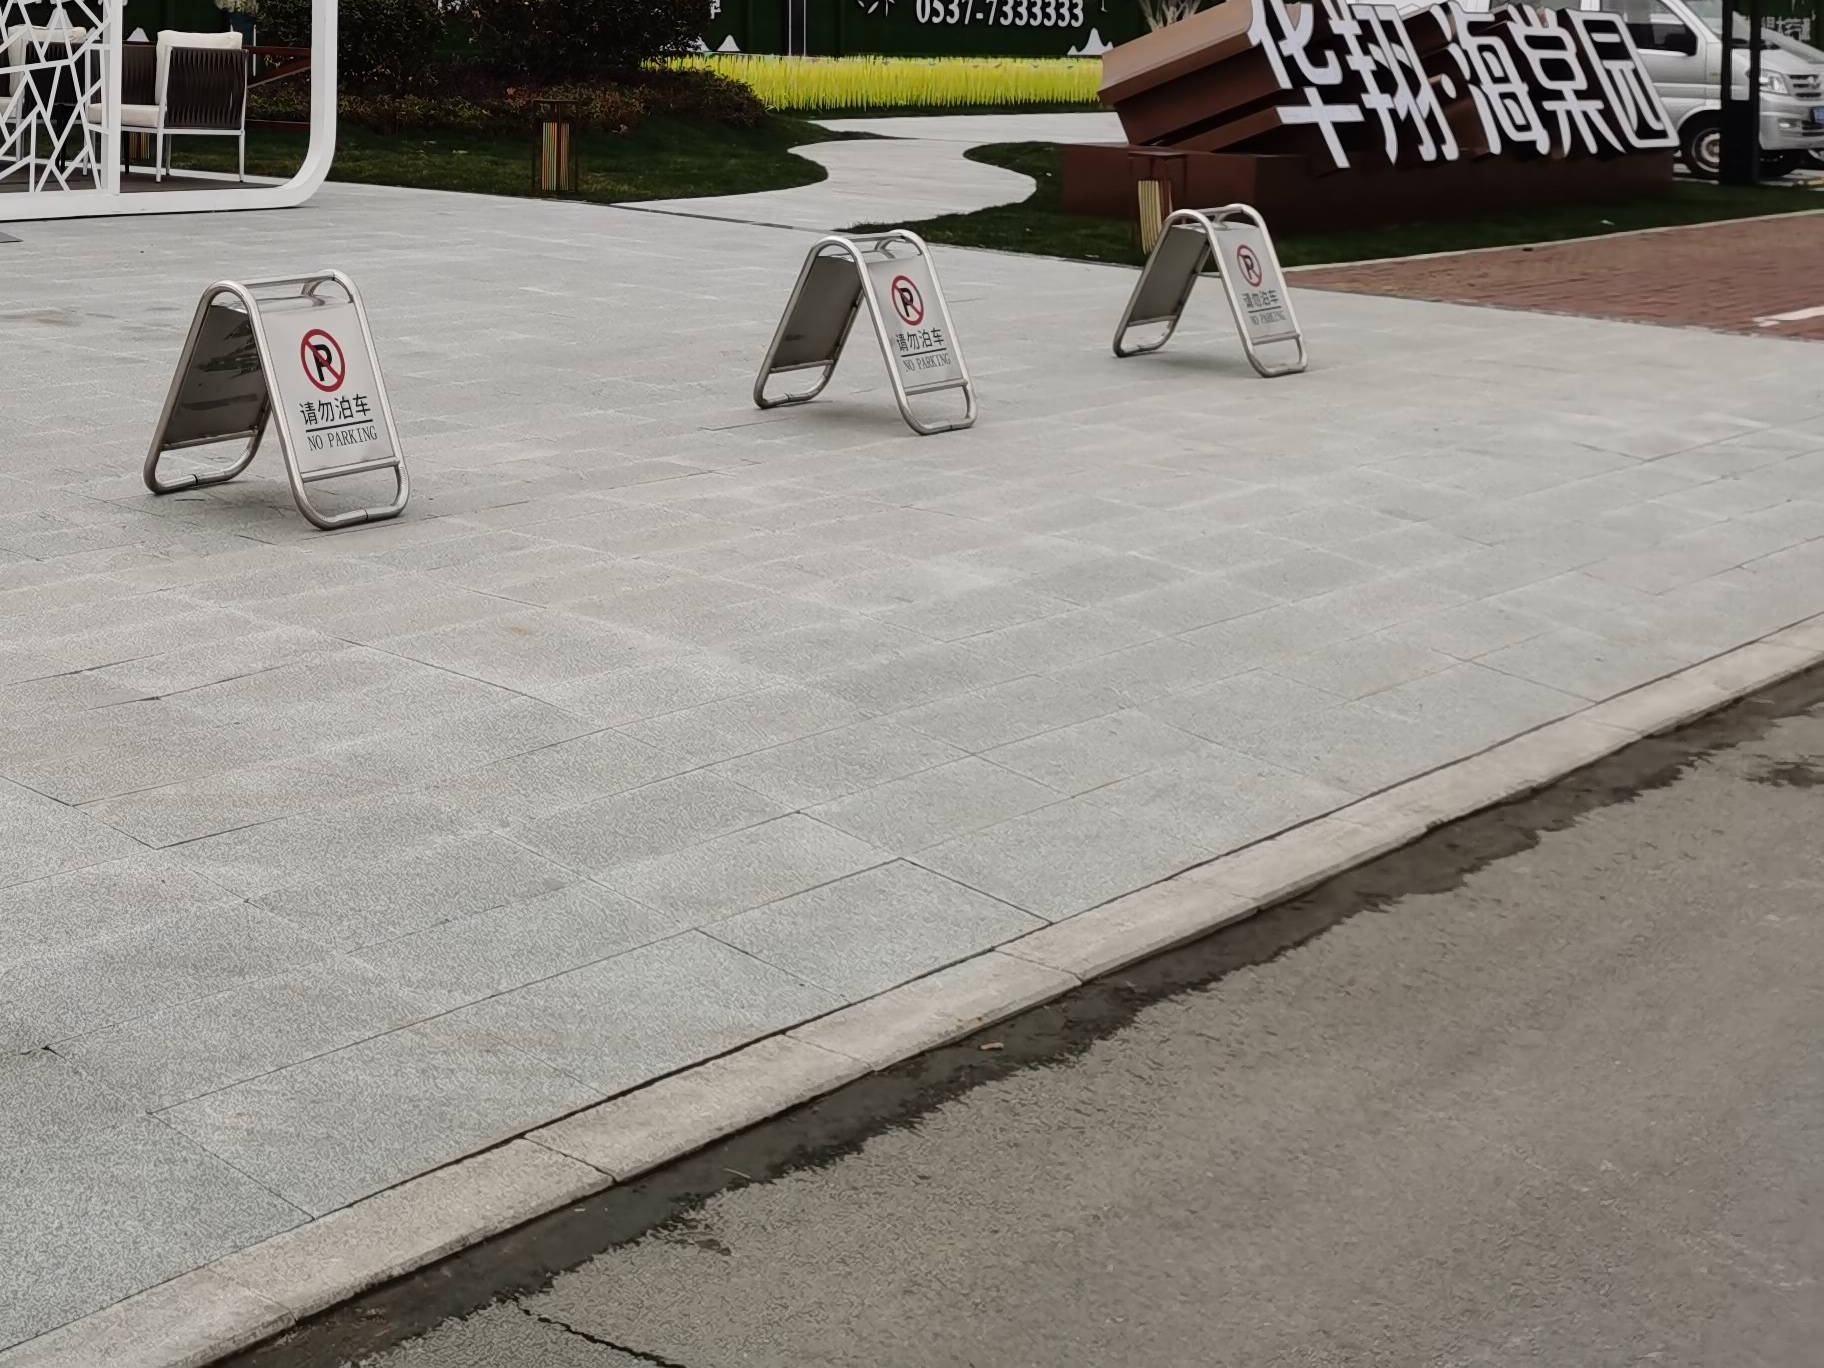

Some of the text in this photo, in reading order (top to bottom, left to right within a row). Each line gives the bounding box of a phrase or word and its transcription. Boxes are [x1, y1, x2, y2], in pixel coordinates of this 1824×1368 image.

[895, 327, 945, 352] 请勿泊车
[902, 352, 952, 373] NO PARKING
[298, 393, 371, 427] 请勿泊车
[307, 425, 378, 452] NO PARKING
